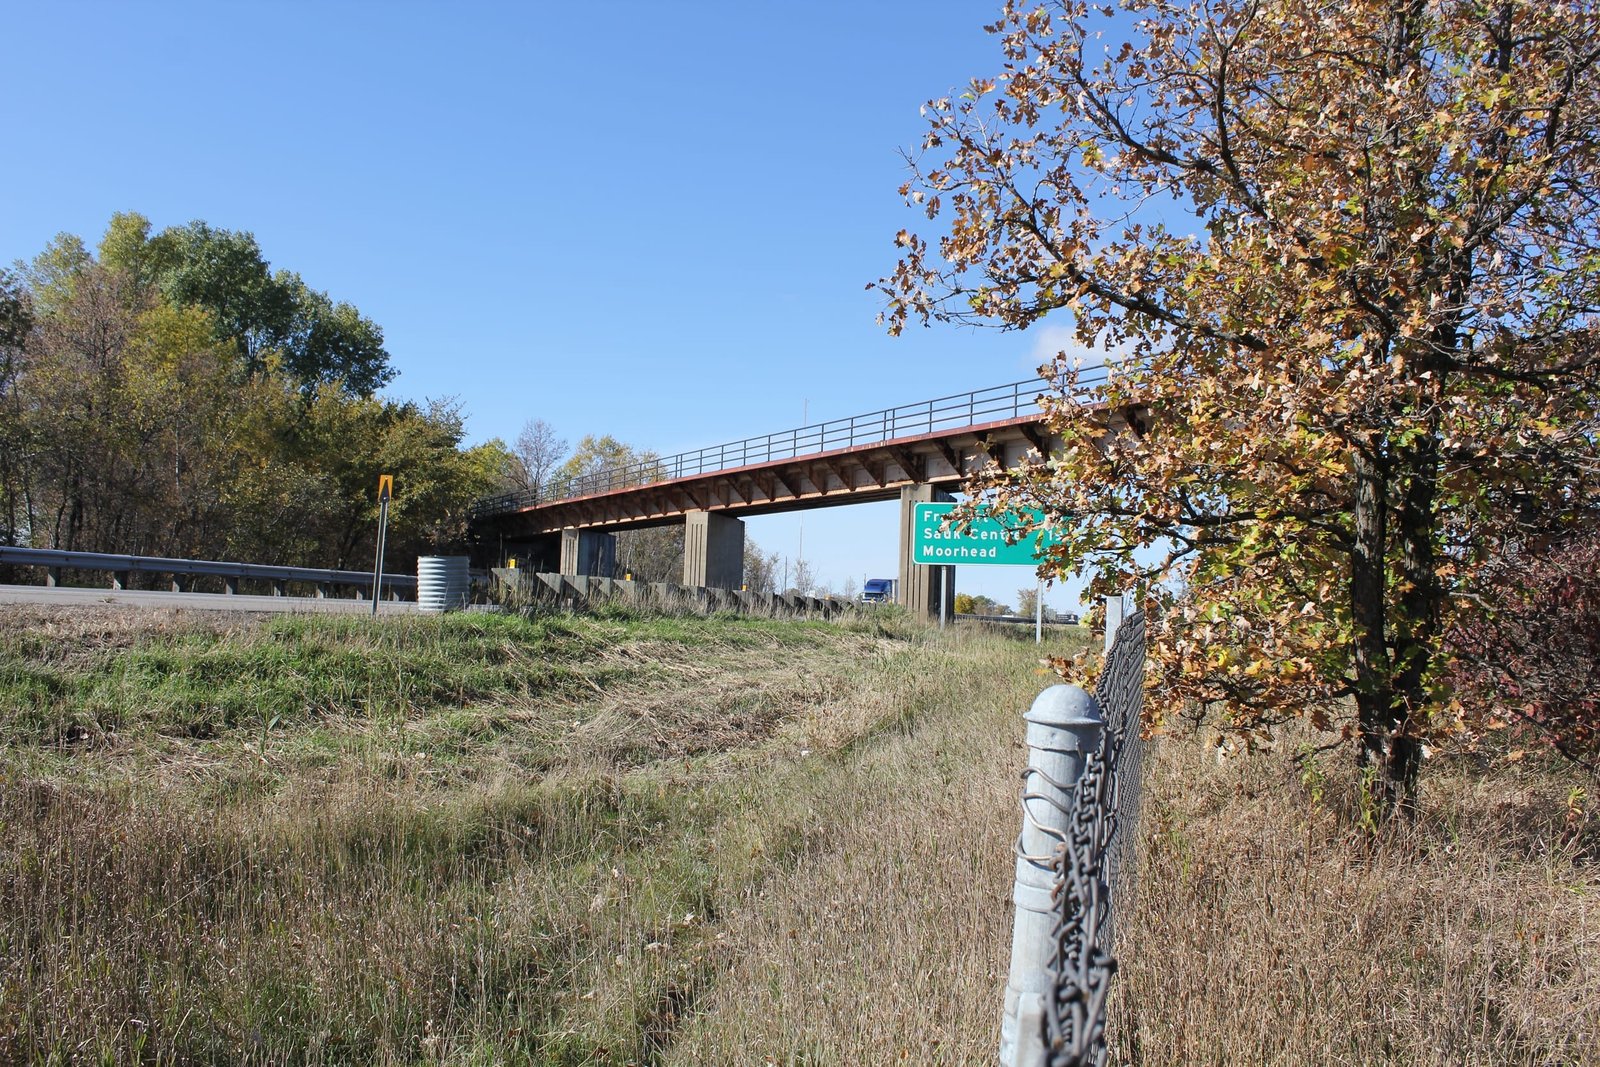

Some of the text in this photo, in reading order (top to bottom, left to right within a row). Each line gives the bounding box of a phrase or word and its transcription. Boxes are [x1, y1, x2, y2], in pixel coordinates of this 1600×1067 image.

[923, 528, 961, 539] Sauk
[971, 528, 1021, 540] Cente
[923, 545, 997, 557] Moorhead
